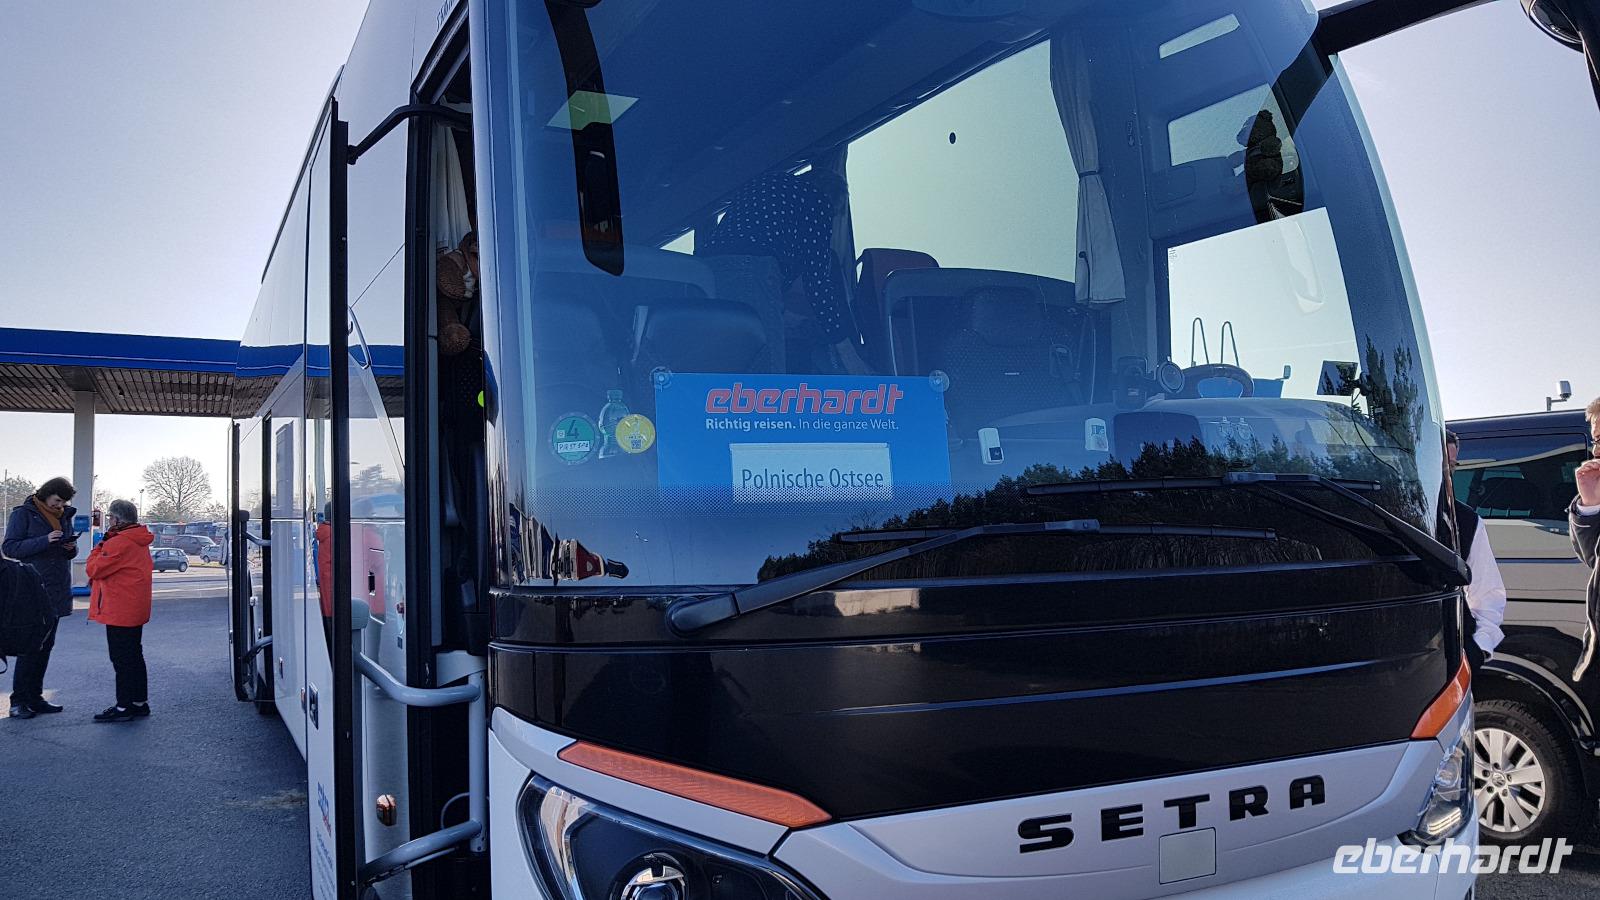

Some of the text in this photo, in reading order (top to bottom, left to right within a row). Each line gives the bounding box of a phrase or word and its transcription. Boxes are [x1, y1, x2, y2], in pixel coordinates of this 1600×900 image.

[705, 382, 904, 414] eberhardt
[566, 419, 579, 439] 4
[705, 418, 899, 432] Richtig reisen. In die ganze Welt.
[742, 468, 884, 490] Polnische Ostsee
[1017, 774, 1326, 853] SETRA
